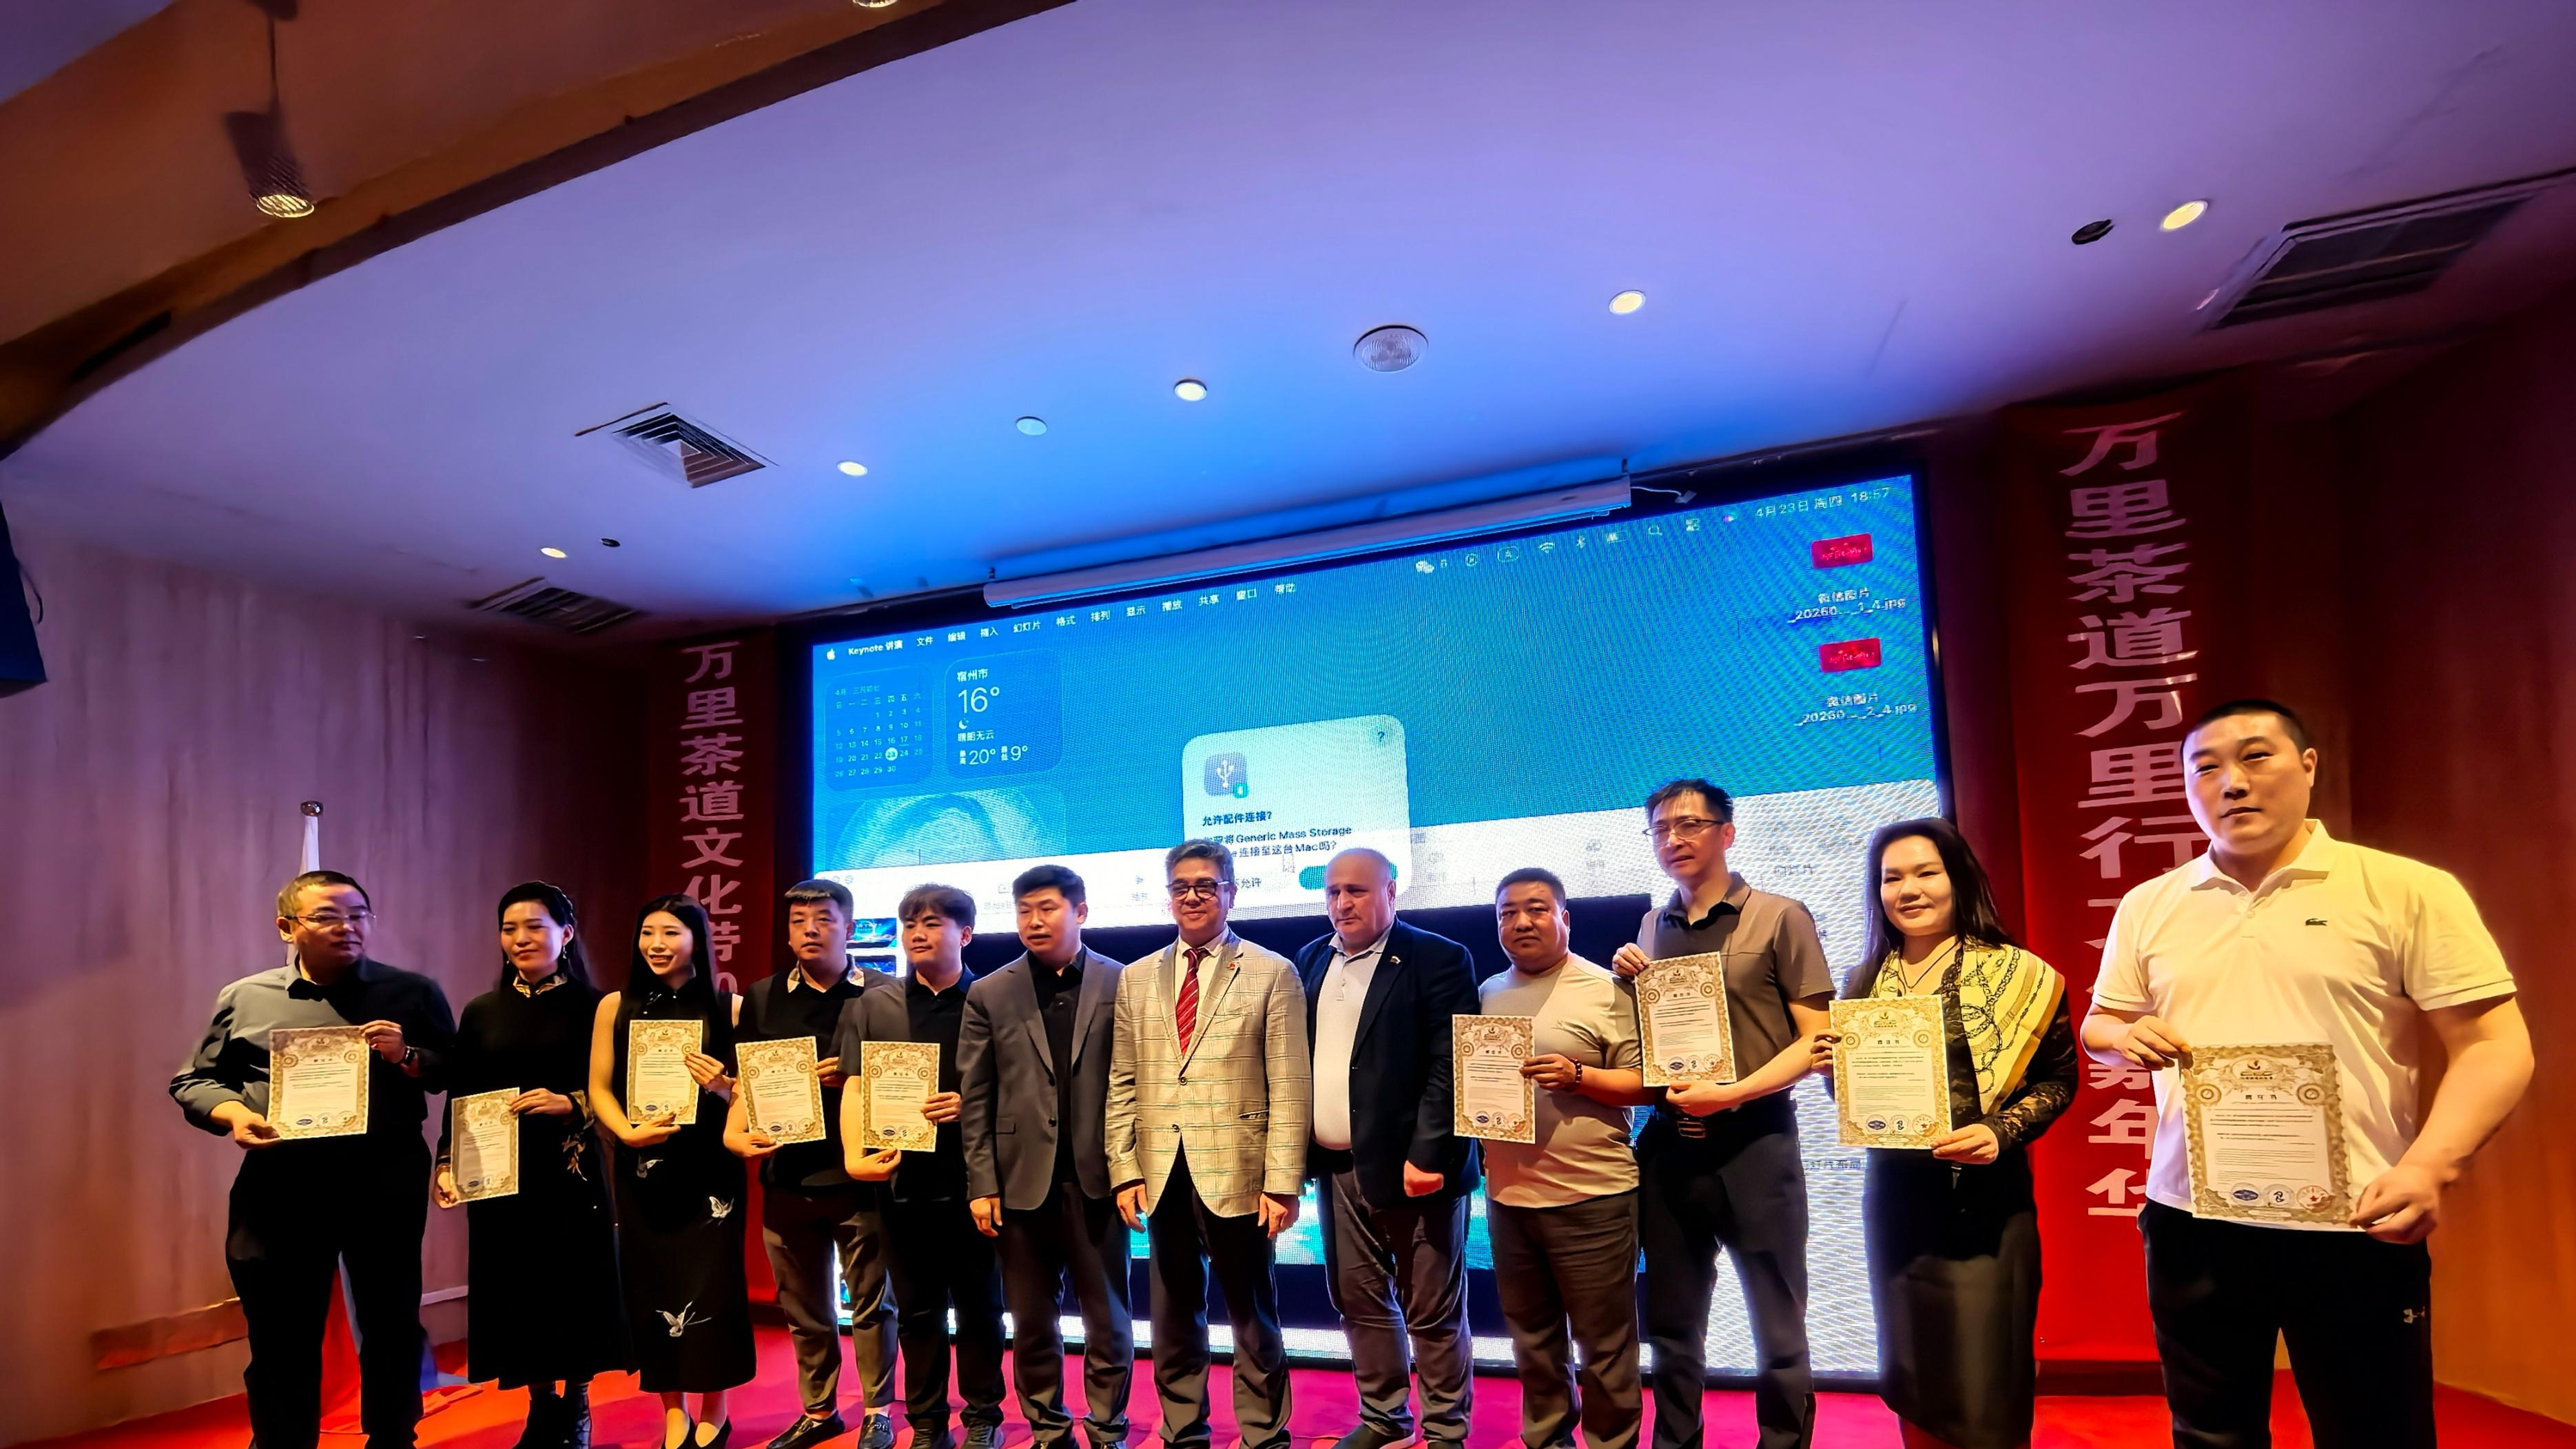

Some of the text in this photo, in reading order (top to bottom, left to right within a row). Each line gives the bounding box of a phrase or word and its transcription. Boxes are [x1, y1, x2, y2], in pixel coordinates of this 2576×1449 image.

[848, 644, 883, 656] Keynote
[916, 636, 934, 647] 文件
[947, 632, 965, 642] 编辑
[980, 626, 998, 637] 插入
[1013, 621, 1041, 633] 幻灯片
[1055, 615, 1076, 627] 格式
[1091, 610, 1110, 623] 排列
[1126, 606, 1146, 617] 显示
[1162, 599, 1182, 612] 播放
[1199, 594, 1219, 606] 共享
[1236, 588, 1257, 602] 窗口
[956, 668, 988, 682] 宿州市
[958, 686, 1000, 713] 16°
[969, 748, 996, 765] 20°
[1011, 745, 1028, 761] 9°
[1203, 811, 1272, 826] 允许配件连接?
[1279, 831, 1306, 841] Mass
[1310, 827, 1352, 839] Storage
